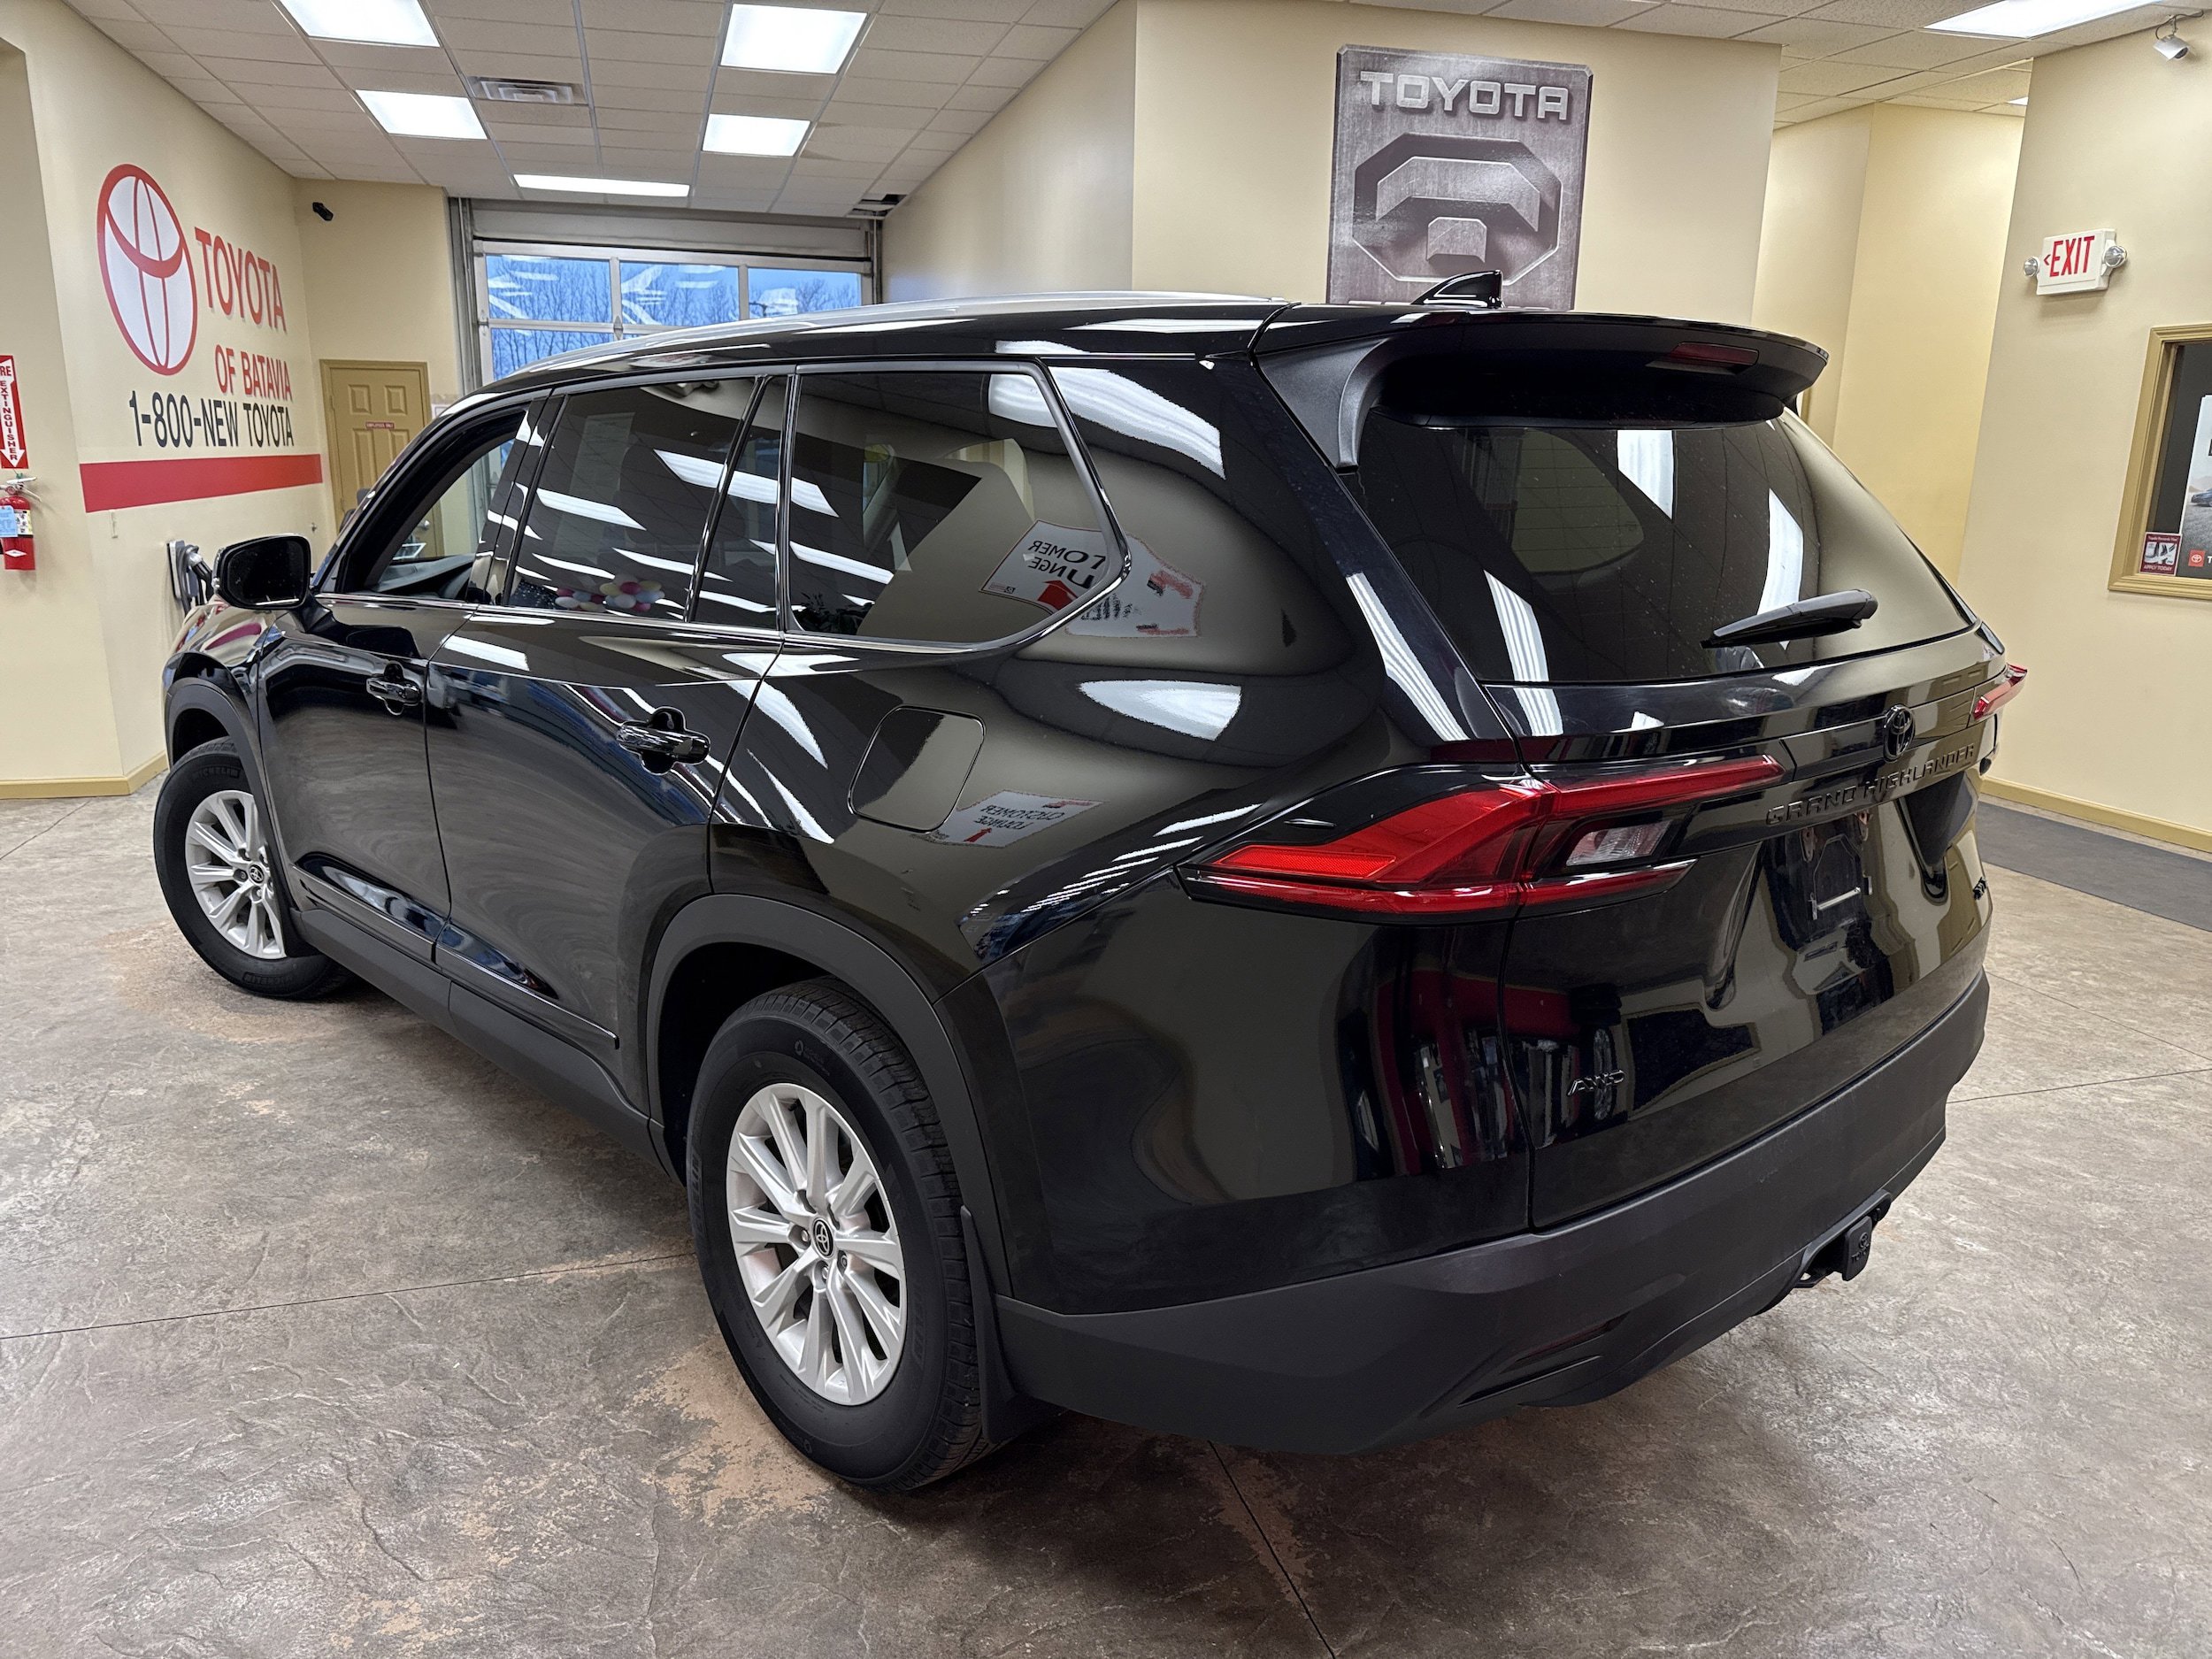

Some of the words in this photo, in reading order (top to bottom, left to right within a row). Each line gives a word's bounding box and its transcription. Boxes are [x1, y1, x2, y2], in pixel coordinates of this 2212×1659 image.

[1361, 71, 1569, 120] TOYOTA
[195, 227, 287, 331] TOYOTA
[2049, 235, 2095, 277] EXIT
[215, 345, 236, 394] OF
[242, 351, 293, 401] BATAVIA
[0, 380, 18, 460] EXTINGUISHER
[129, 390, 239, 448] 1-800-NEW
[243, 403, 294, 447] TOYOTA
[1766, 787, 1856, 826] GRAND
[1863, 743, 1974, 798] HIGHLANDER
